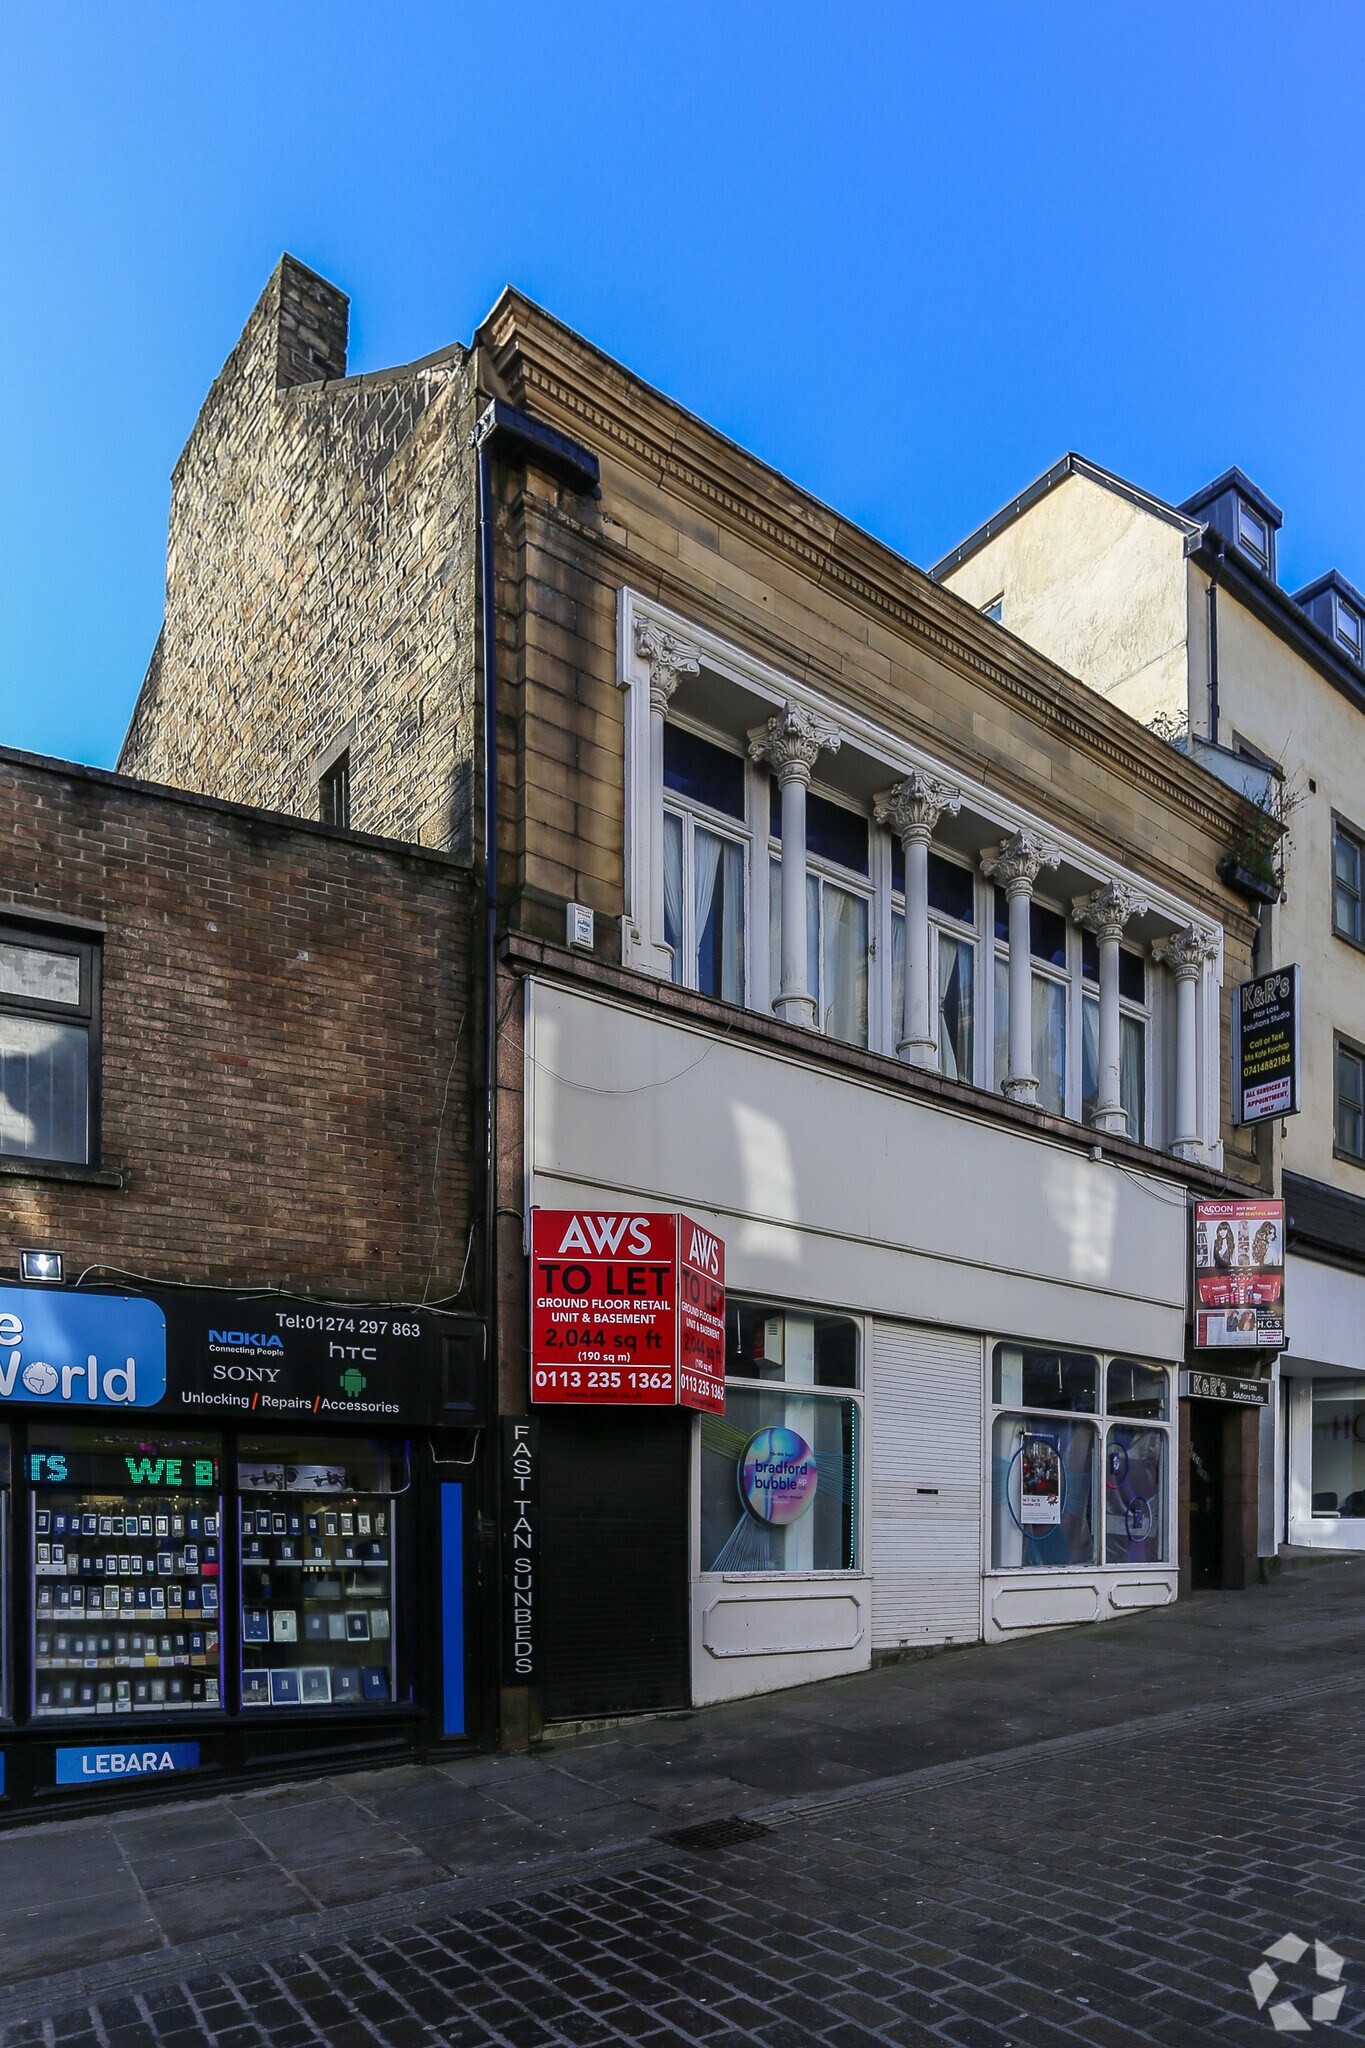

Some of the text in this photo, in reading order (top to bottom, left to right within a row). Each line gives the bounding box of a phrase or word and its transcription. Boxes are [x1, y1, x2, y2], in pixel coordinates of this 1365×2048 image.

[1242, 974, 1290, 1012] K&R's
[1243, 1011, 1290, 1033] Solutions Studio
[1253, 1004, 1280, 1019] Hair Loss
[1250, 1038, 1263, 1050] Call
[1271, 1032, 1284, 1043] Text
[1244, 1054, 1290, 1077] 07414882184
[1246, 1080, 1290, 1099] ALL SERVICES BY
[1198, 1205, 1233, 1216] RACOON
[558, 1215, 652, 1256] AWS
[688, 1226, 719, 1276] AWS
[538, 1264, 670, 1297] TO LET
[682, 1269, 724, 1316] TO LET
[537, 1298, 671, 1311] GROUND FLOOR RETAIL
[682, 1301, 699, 1318] GROUND
[699, 1310, 712, 1324] FLOOR
[275, 1312, 420, 1337] Tel:01274 297 863
[551, 1312, 656, 1324] UNIT & BASEMENT
[686, 1318, 696, 1330] UNIT
[700, 1323, 720, 1340] BASEMENT
[1257, 1320, 1282, 1328] H.C.S.
[208, 1330, 284, 1348] NOKIA
[545, 1329, 662, 1352] 2,044 sq ft
[684, 1332, 704, 1356] 2,044
[209, 1344, 284, 1358] Connecting People
[578, 1351, 631, 1363] (190 sq m)
[213, 1364, 281, 1383] SONY
[535, 1370, 672, 1389] 0113 235 1362
[680, 1373, 724, 1401] 0113 235 1362
[1193, 1374, 1227, 1397] K&R's
[1232, 1391, 1264, 1402] Solutions Studio
[1240, 1382, 1258, 1392] Hair Loss
[182, 1391, 250, 1408] Unlocking
[262, 1395, 312, 1412] Repairs
[321, 1398, 400, 1413] Accessories
[124, 1457, 182, 1484] WE
[755, 1459, 808, 1475] bradford
[754, 1476, 808, 1490] bubble up
[512, 1425, 533, 1674] FAST TAN SUNBEDS
[82, 1751, 175, 1774] LEBARA
